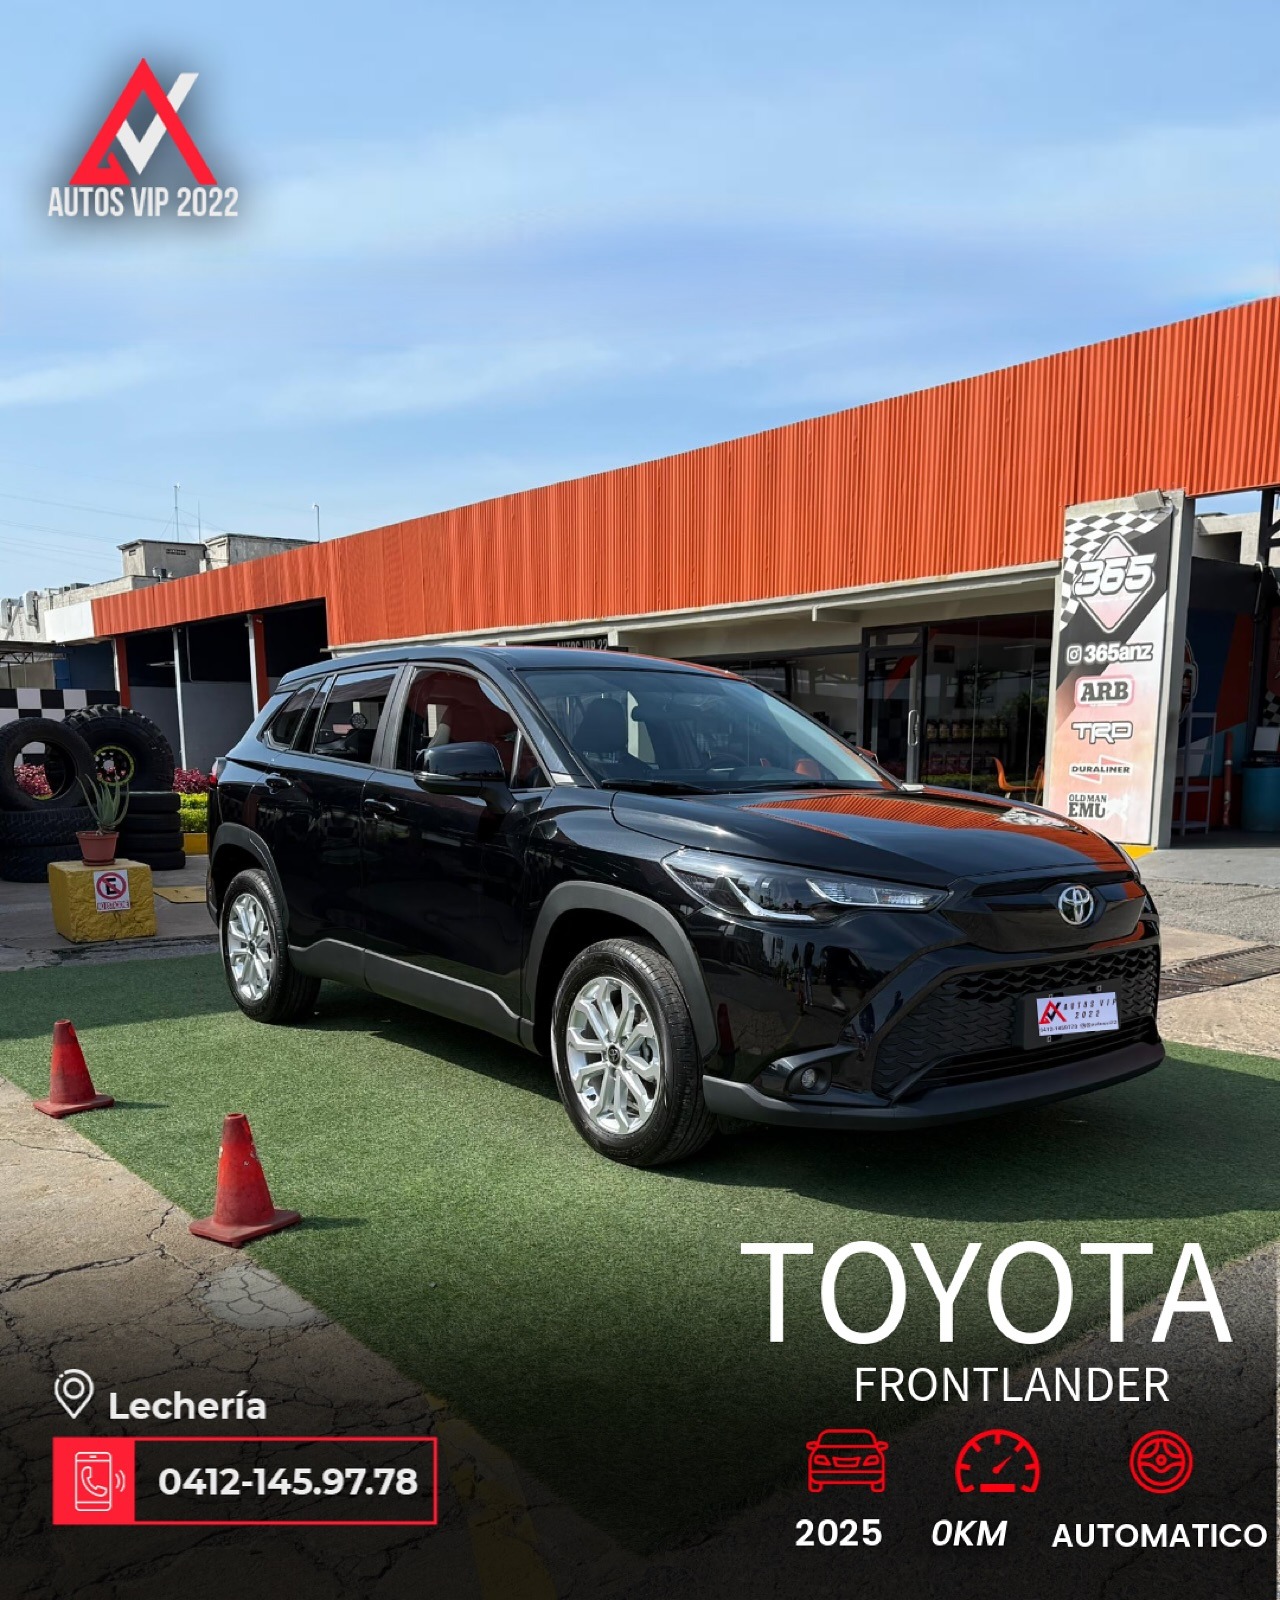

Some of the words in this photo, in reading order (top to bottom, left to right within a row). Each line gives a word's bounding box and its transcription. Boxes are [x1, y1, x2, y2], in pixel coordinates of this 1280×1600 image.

[1075, 553, 1157, 596] 365
[1084, 643, 1153, 662] 365anz
[1080, 681, 1129, 702] ARB
[1071, 721, 1133, 744] TRD
[1071, 766, 1131, 774] DURALINER
[1068, 793, 1086, 802] OLD
[1087, 794, 1107, 802] MAN
[1068, 802, 1106, 818] EMU
[1063, 999, 1095, 1010] AUTOS
[1074, 1010, 1101, 1019] 2022
